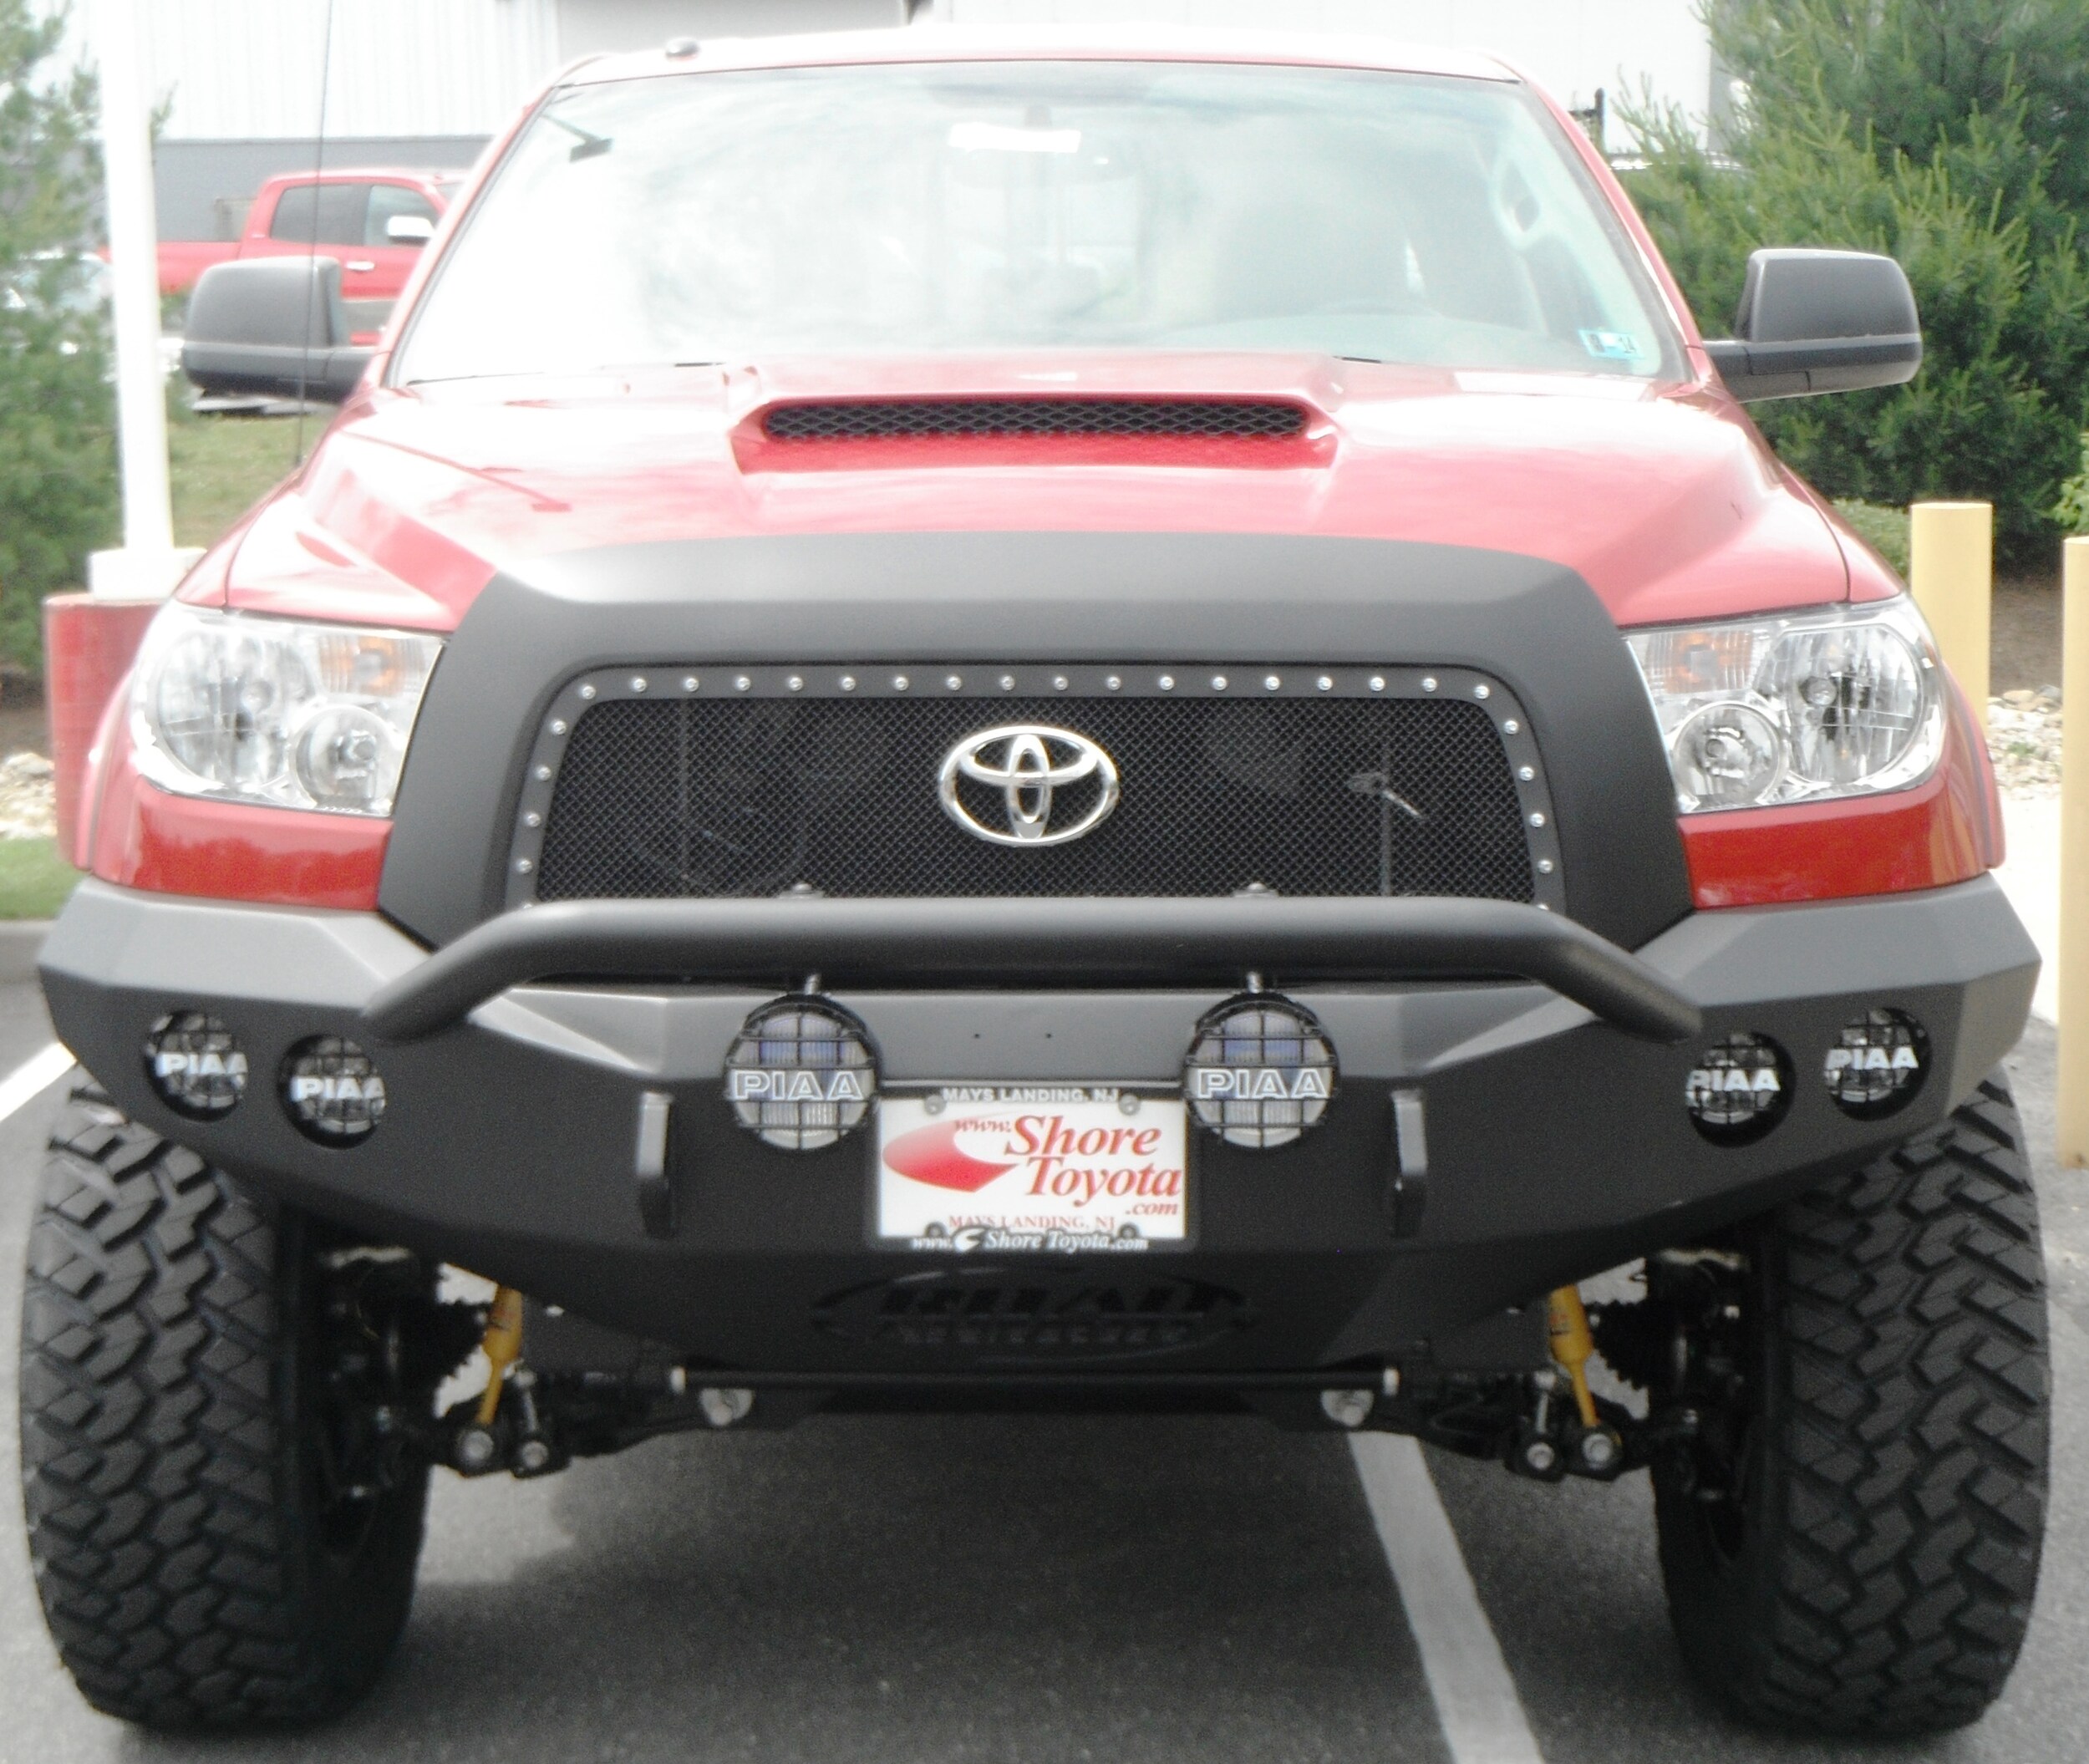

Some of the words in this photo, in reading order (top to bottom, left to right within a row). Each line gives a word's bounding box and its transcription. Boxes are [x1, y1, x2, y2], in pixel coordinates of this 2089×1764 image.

[155, 1050, 248, 1078] PIAA
[1824, 1046, 1919, 1070] PIAA
[290, 1075, 385, 1103] PIAA
[731, 1070, 864, 1101] PIAA
[1197, 1068, 1329, 1099] PIAA
[1685, 1069, 1781, 1091] PIAA
[943, 1088, 995, 1101] MAYS
[1093, 1088, 1119, 1101] NJ
[1004, 1115, 1161, 1155] Shore
[1024, 1156, 1182, 1207] Toyota
[984, 1230, 1044, 1249] Shore
